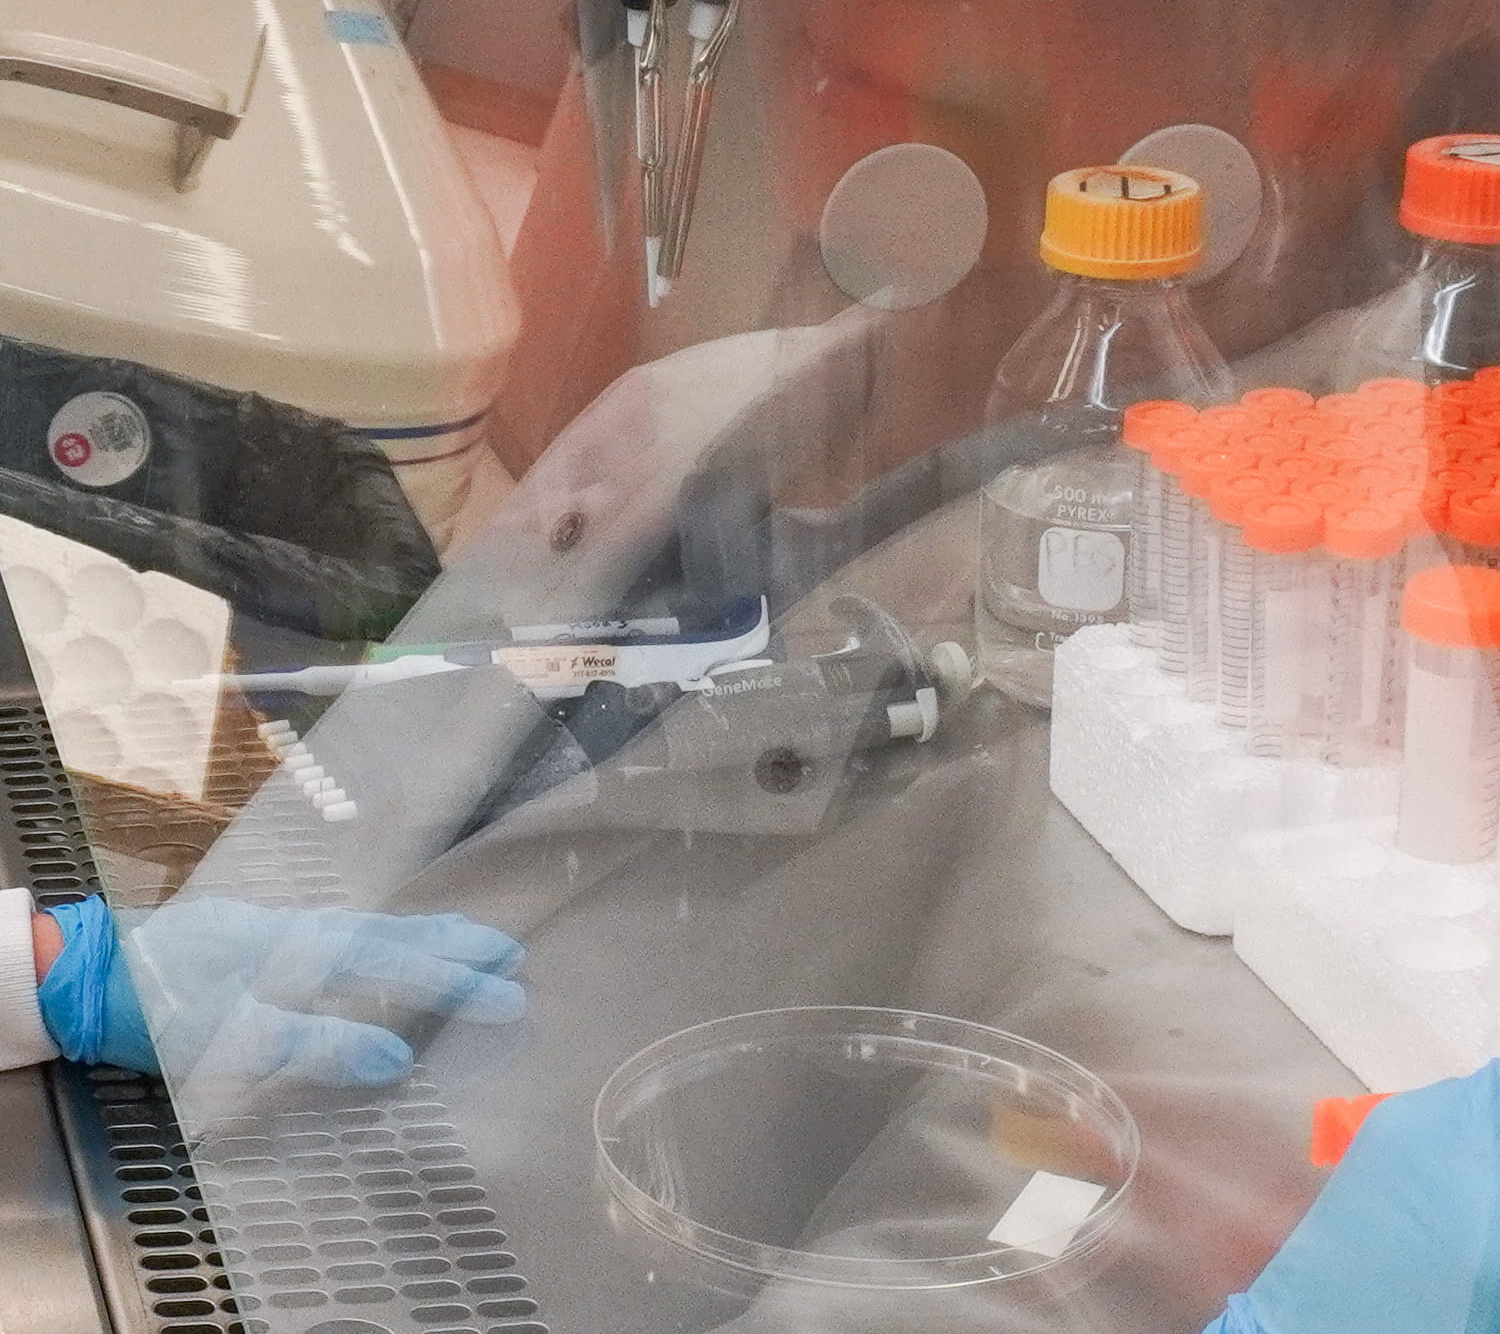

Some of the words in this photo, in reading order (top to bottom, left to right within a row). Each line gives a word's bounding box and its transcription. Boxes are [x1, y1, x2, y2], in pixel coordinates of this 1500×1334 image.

[1053, 485, 1087, 503] 500
[1057, 504, 1109, 522] PYREX
[701, 675, 783, 698] GeneMae
